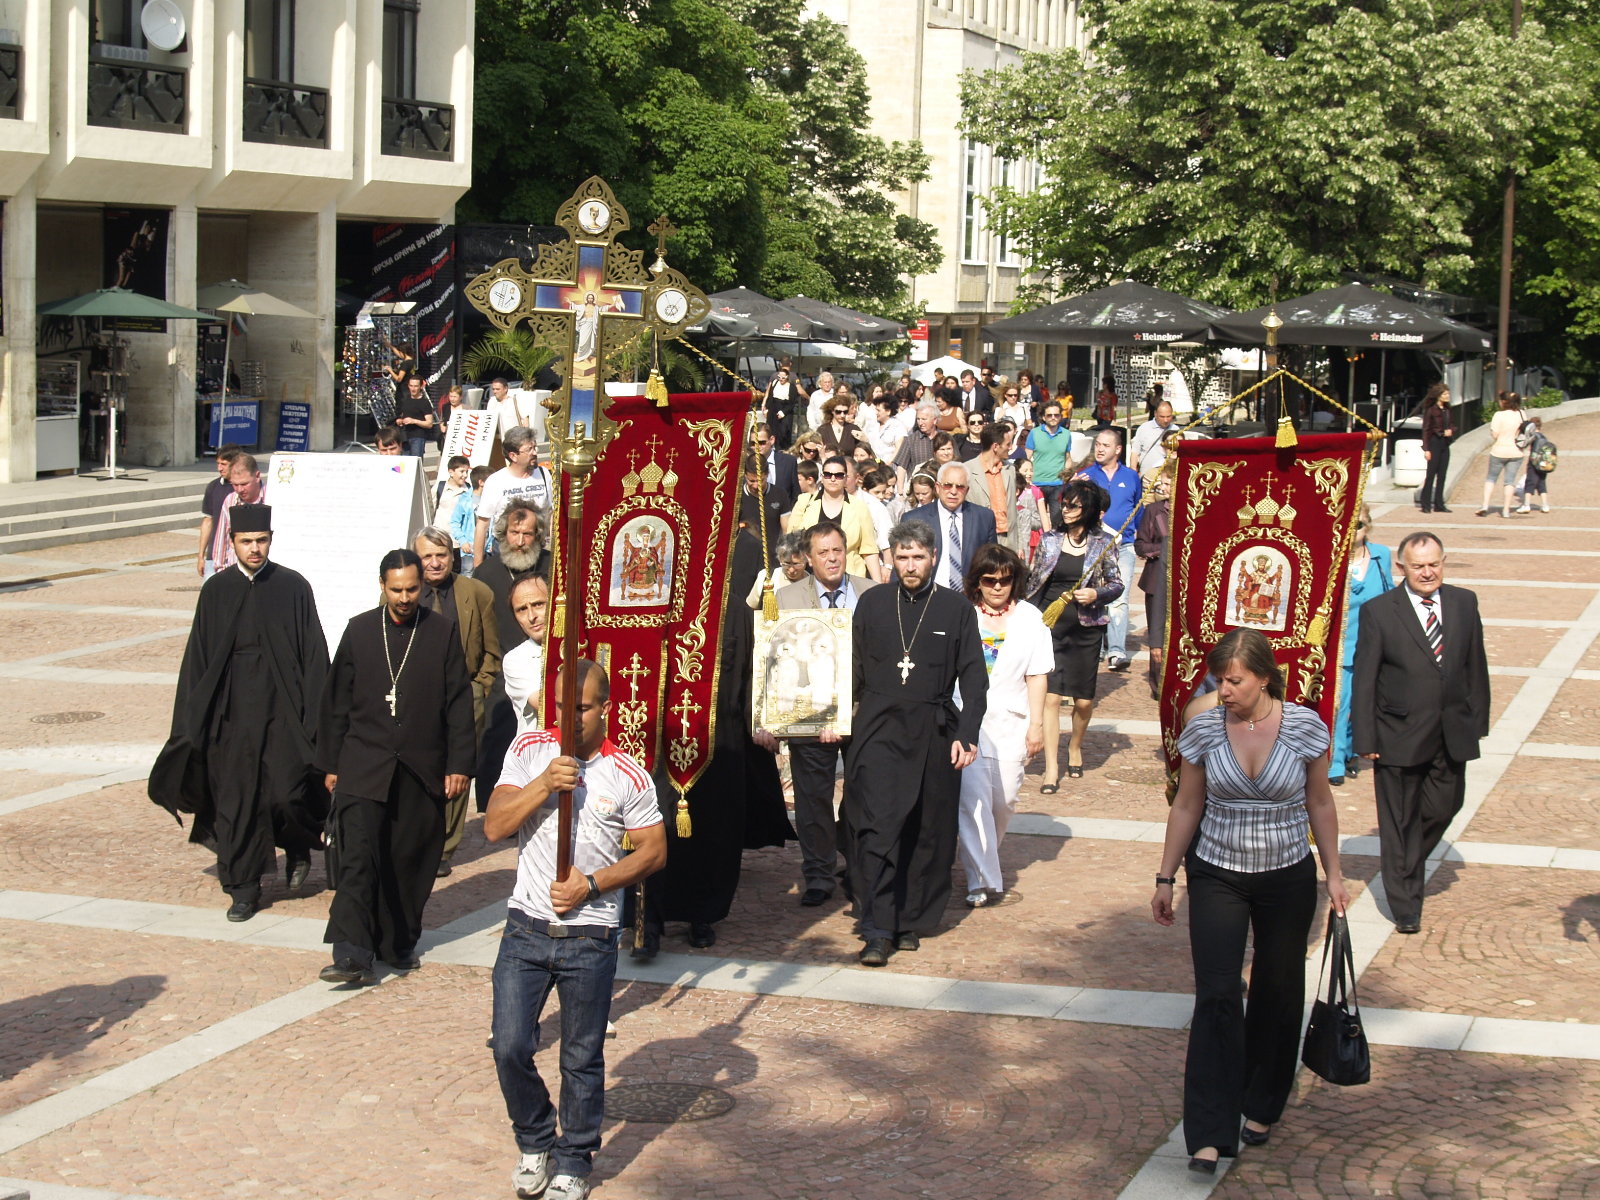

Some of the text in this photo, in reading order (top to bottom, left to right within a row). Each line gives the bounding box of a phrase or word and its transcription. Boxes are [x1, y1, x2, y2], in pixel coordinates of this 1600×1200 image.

[416, 303, 434, 320] НОВА
[1142, 333, 1183, 341] Heineken
[1380, 333, 1424, 342] Heineken
